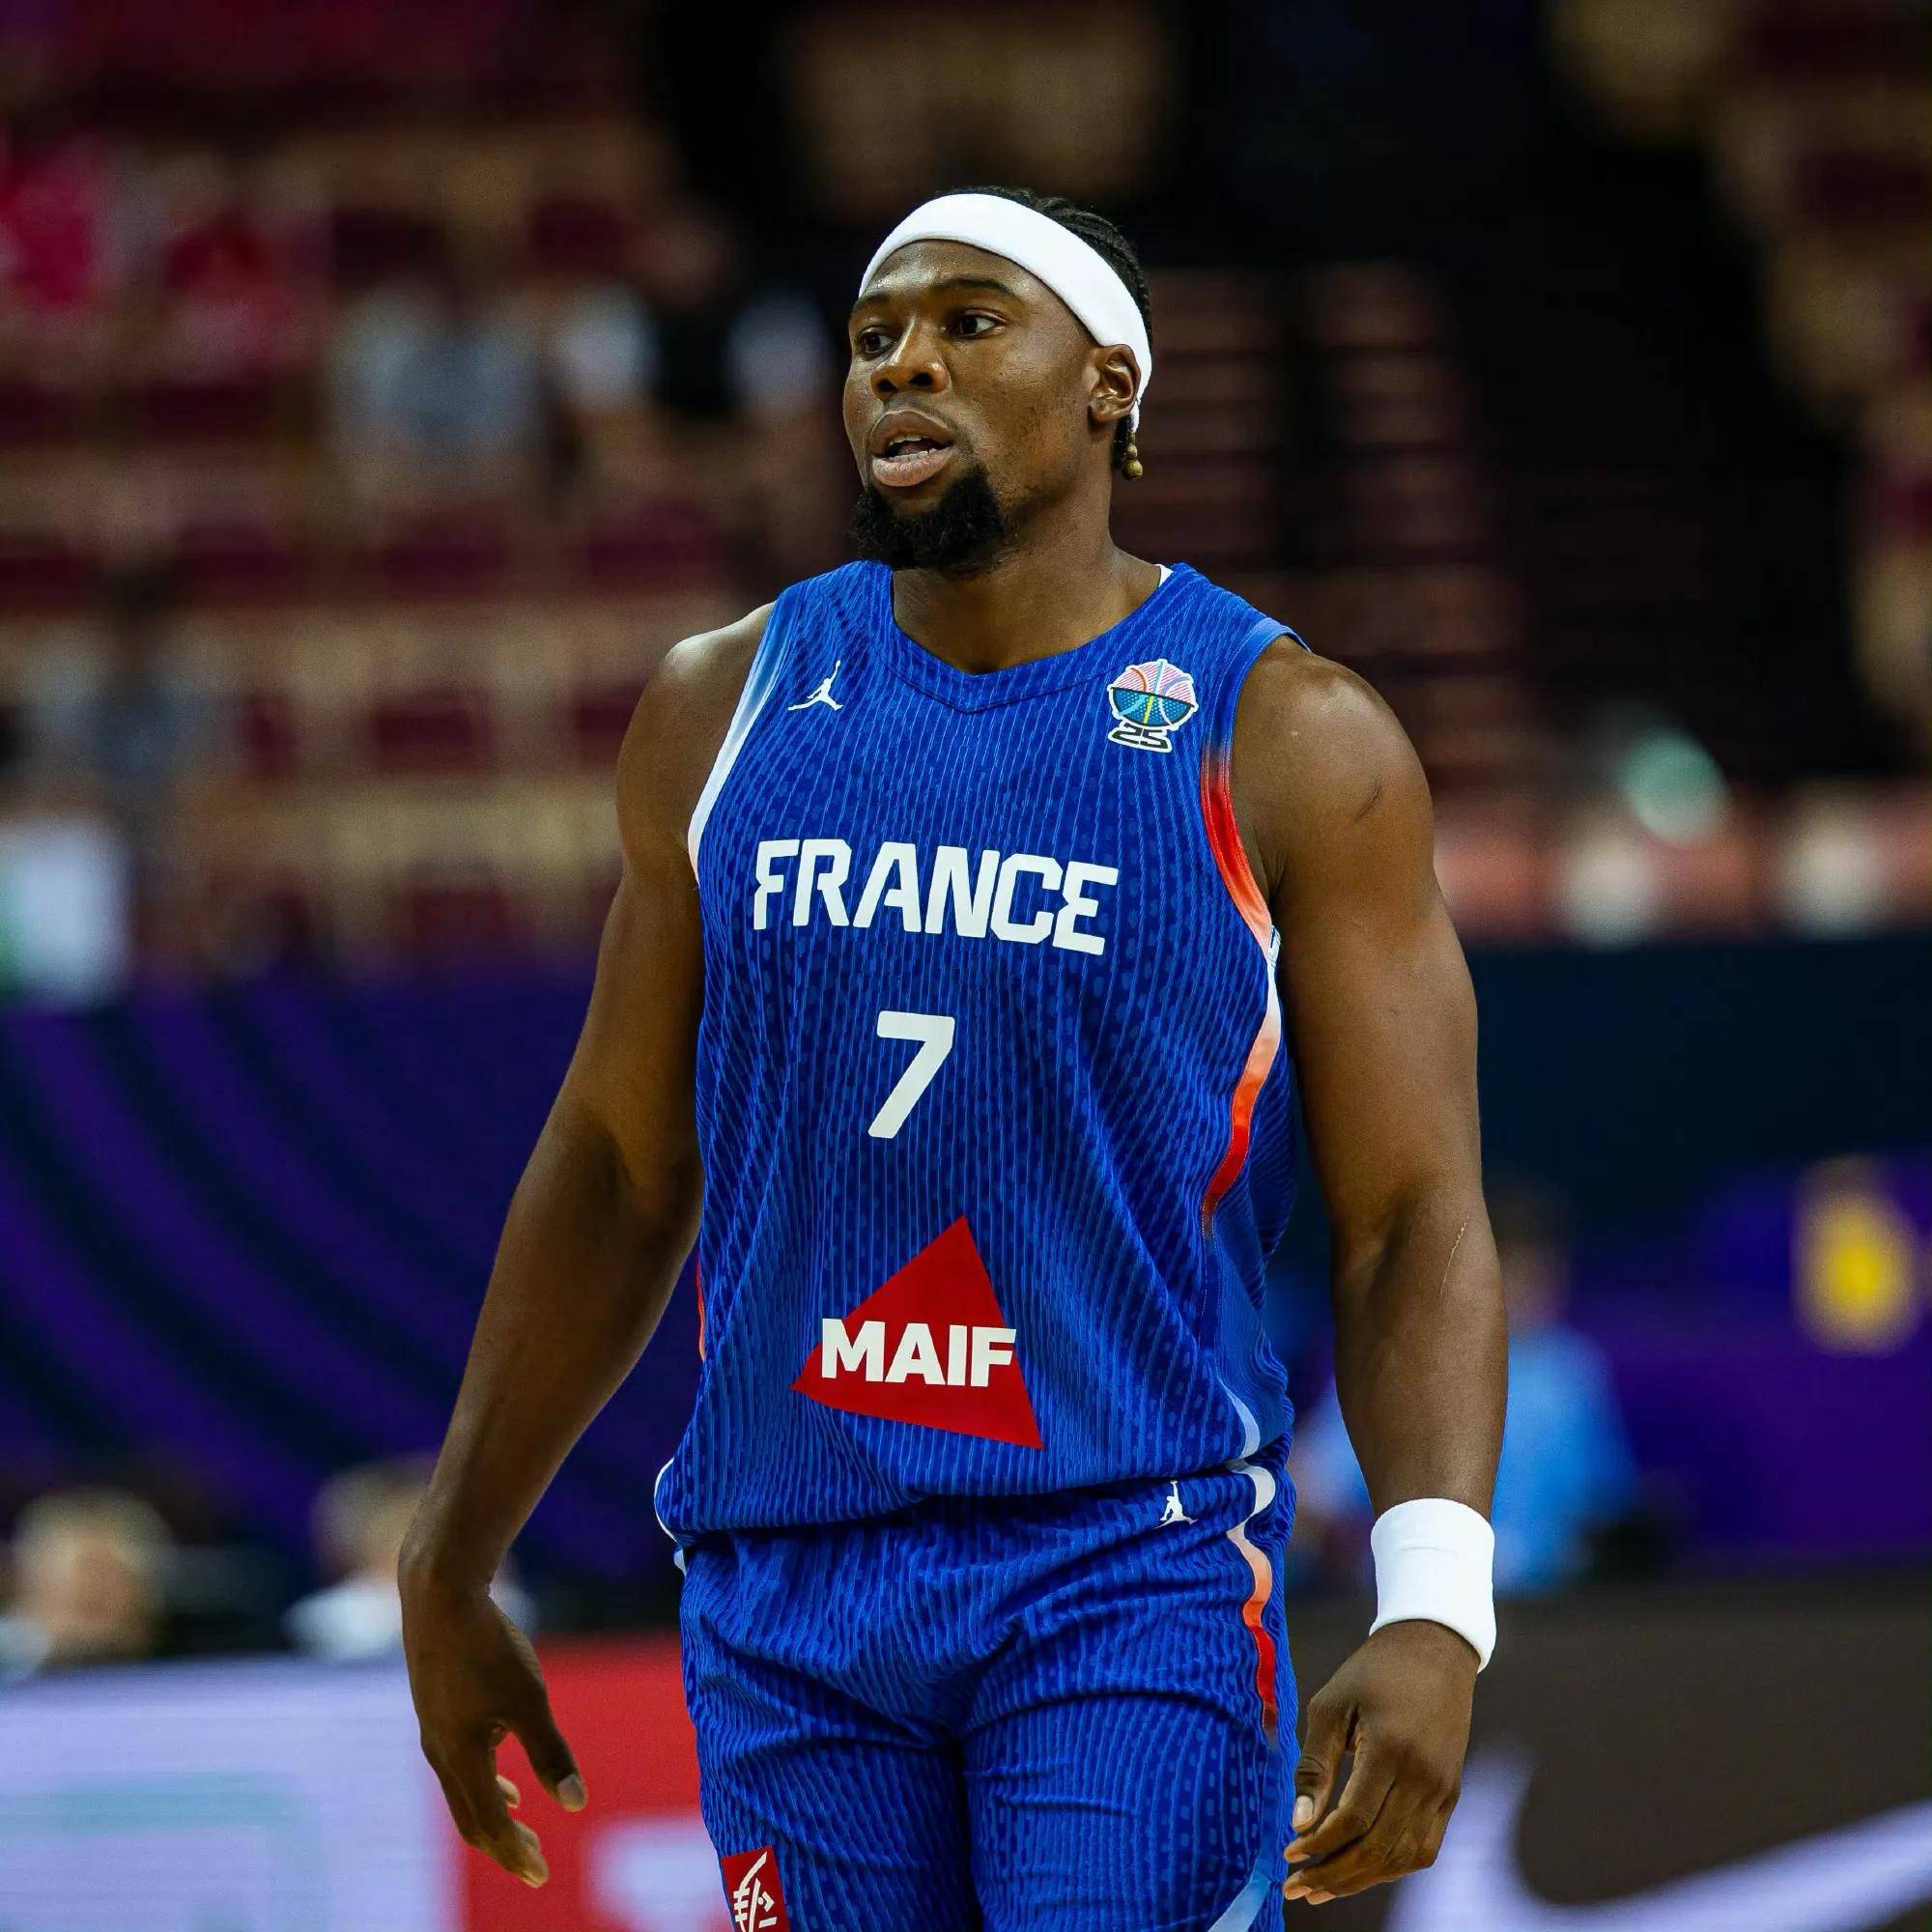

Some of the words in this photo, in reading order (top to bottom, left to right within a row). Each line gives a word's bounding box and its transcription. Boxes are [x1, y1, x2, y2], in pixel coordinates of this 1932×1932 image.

[1109, 721, 1172, 752] 25
[753, 838, 1119, 955] FRANCE
[867, 1010, 955, 1139] 7
[822, 1318, 1016, 1387] MAIF
